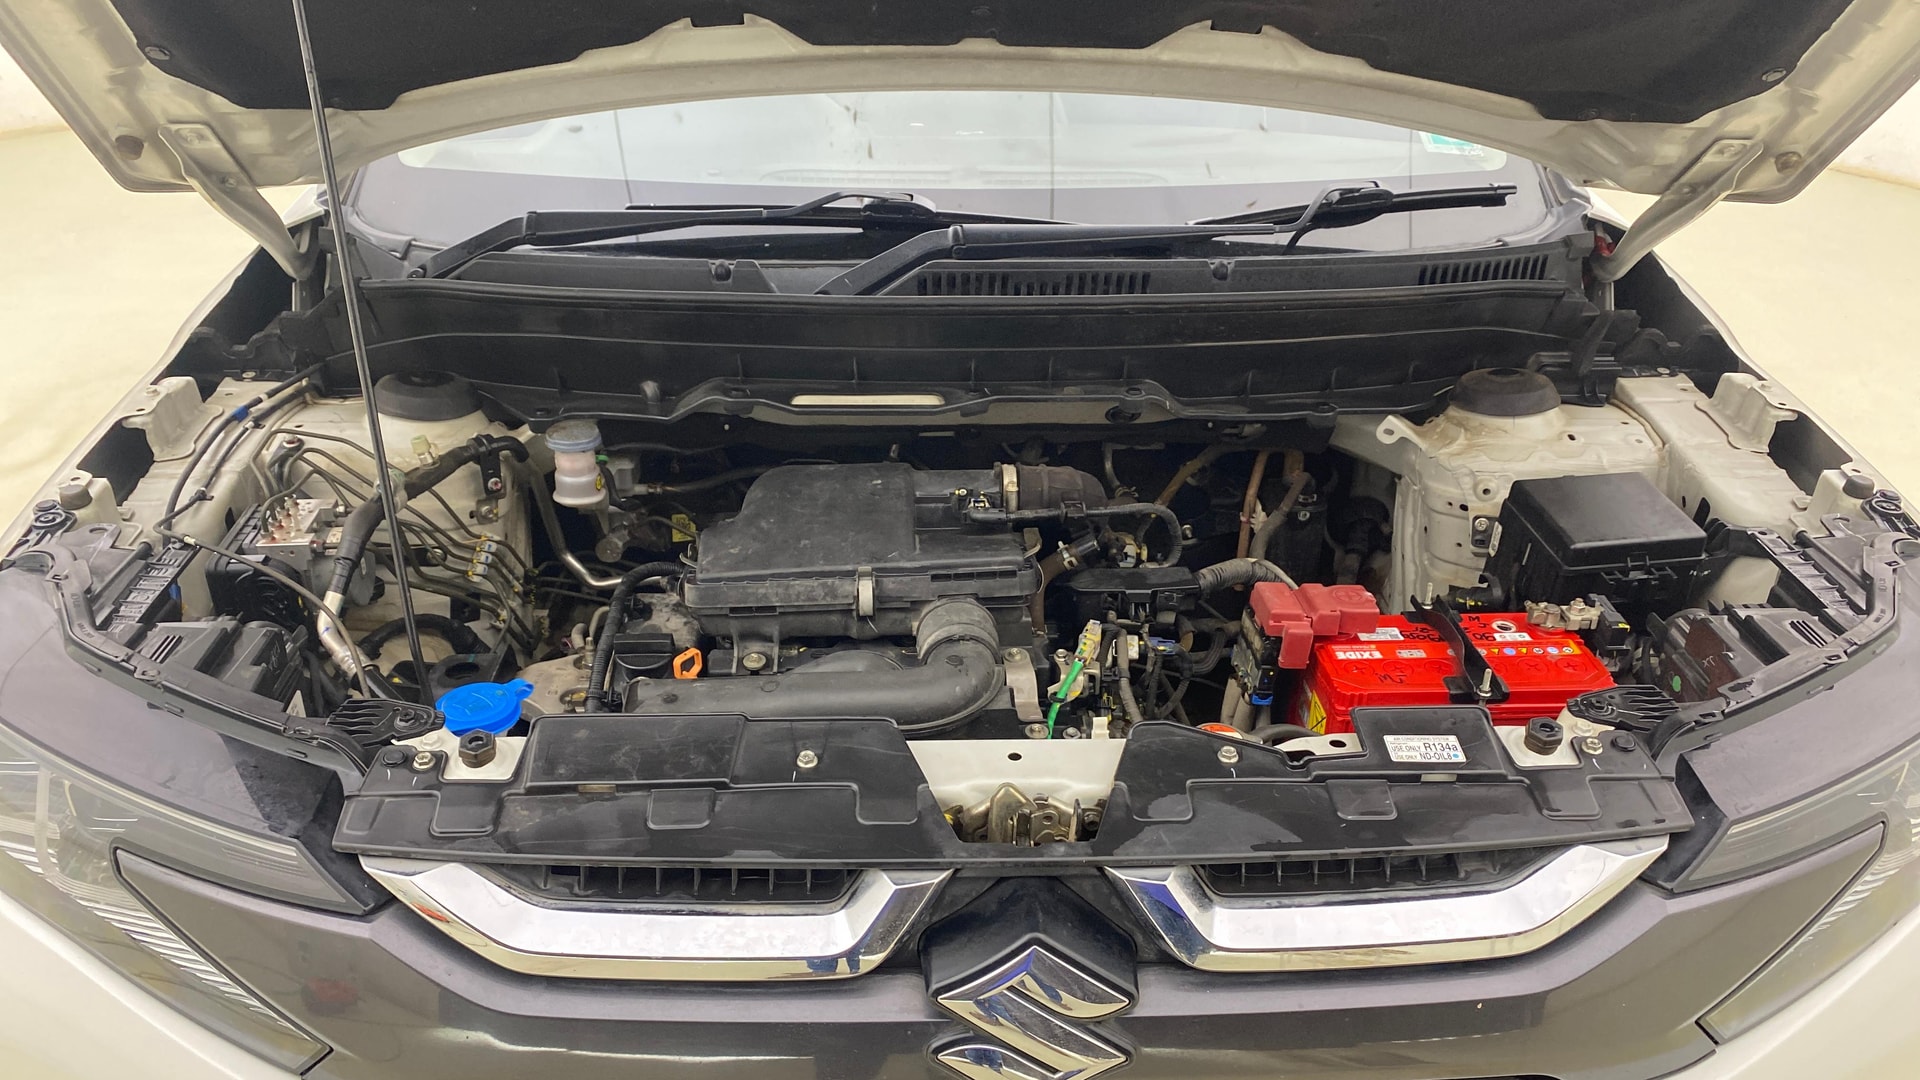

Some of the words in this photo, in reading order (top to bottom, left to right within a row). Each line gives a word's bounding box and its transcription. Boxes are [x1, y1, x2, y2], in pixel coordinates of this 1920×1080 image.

[1335, 651, 1383, 660] EXIDE
[1423, 742, 1458, 752] R134a
[1419, 752, 1453, 760] ND-OIL8
